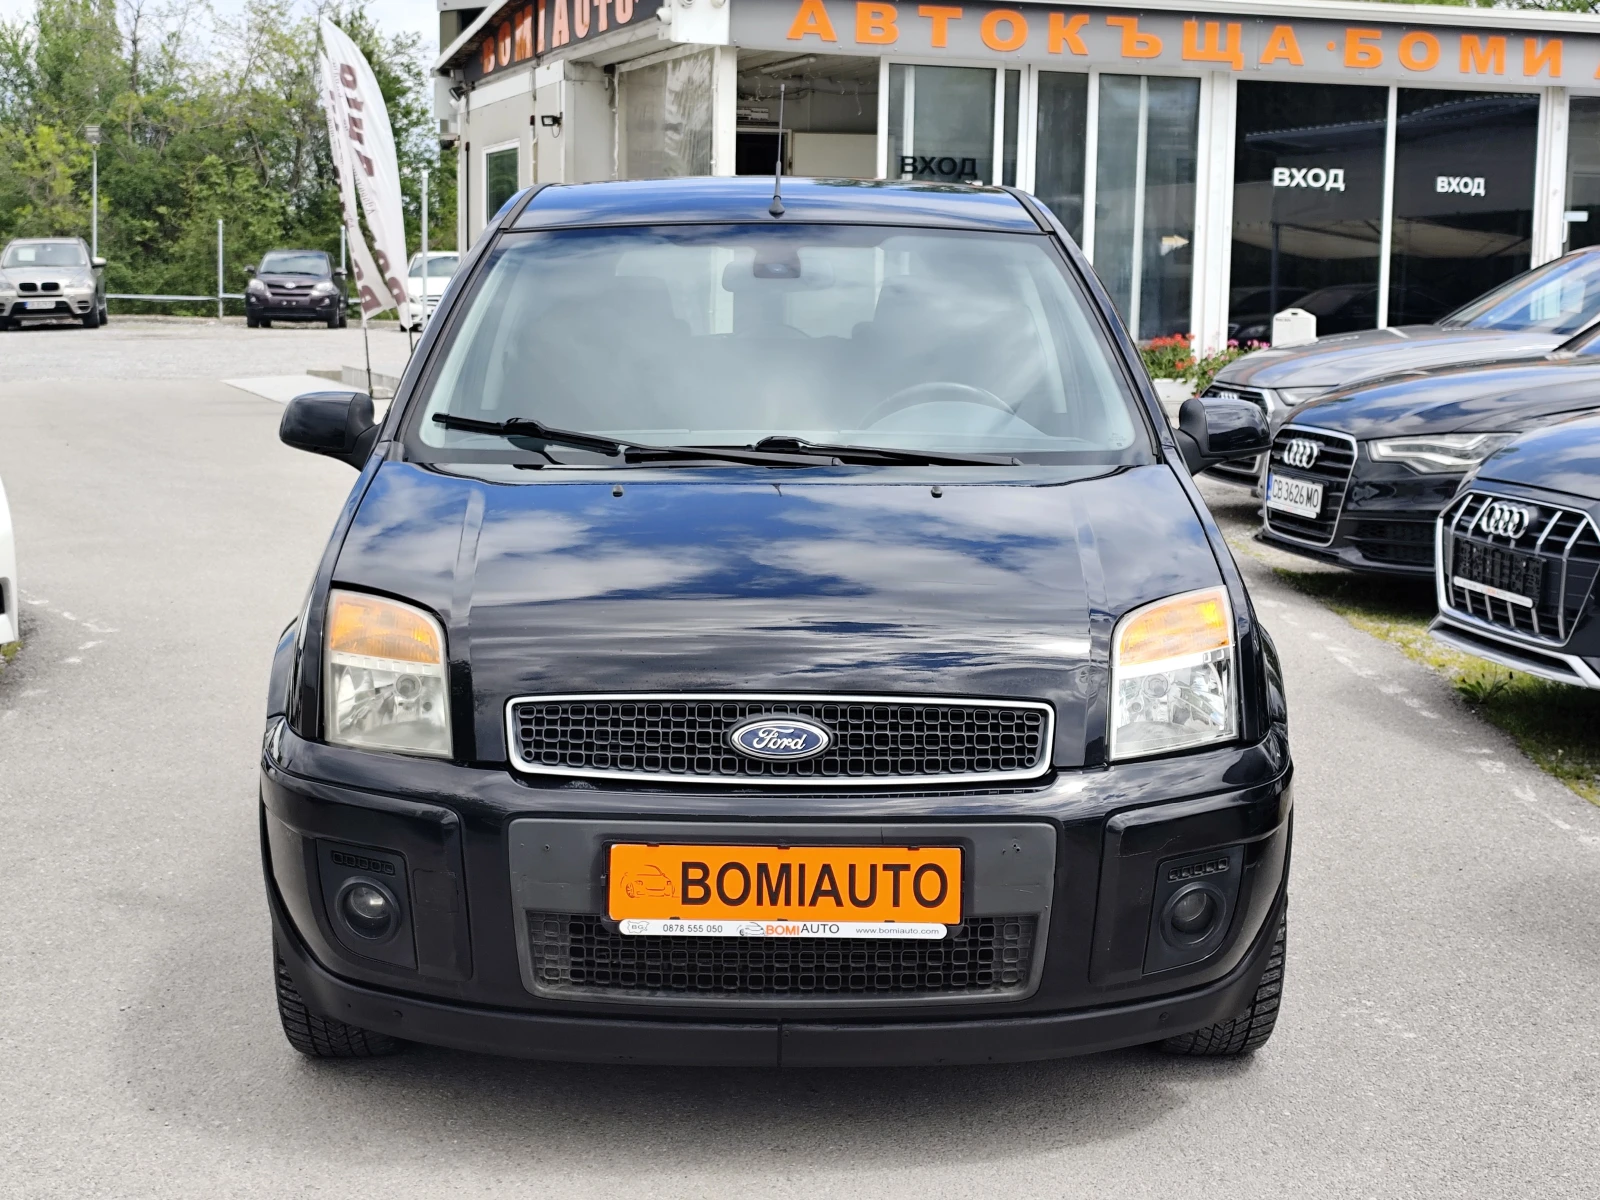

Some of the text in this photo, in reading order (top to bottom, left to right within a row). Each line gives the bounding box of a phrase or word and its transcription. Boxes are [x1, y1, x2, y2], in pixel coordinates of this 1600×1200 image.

[481, 0, 546, 74] BOMI
[787, 0, 1563, 78] АВТОКЪЩА БОМИ
[901, 156, 978, 180] ВХОД
[1273, 167, 1345, 192] ВХОД
[1436, 176, 1486, 196] ВХОД
[753, 727, 807, 749] Ford
[681, 861, 948, 908] BOMIAUTO
[662, 924, 723, 933] 0878 555 050
[855, 927, 940, 935] www.bomiauto.com
